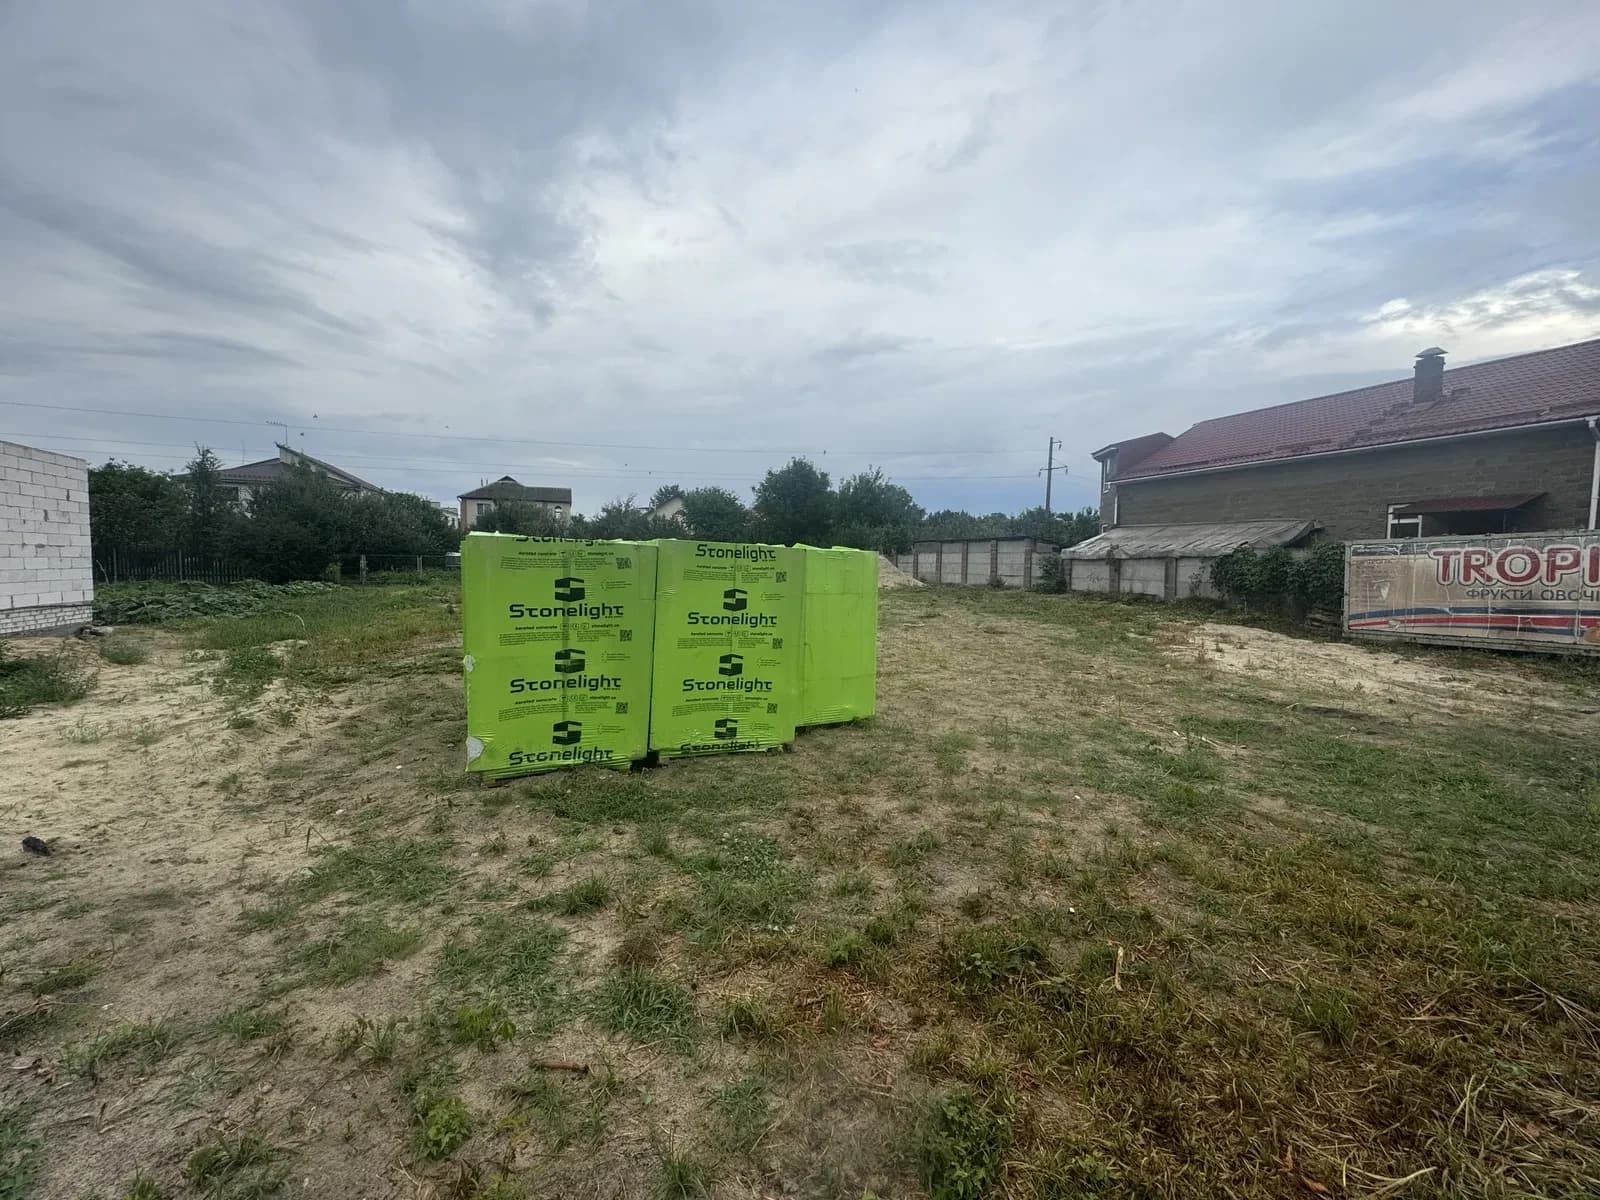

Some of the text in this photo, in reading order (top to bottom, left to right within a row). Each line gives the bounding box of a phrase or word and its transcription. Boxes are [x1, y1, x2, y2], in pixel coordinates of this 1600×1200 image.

[695, 544, 776, 562] Stonelight
[1429, 544, 1600, 587] TROPI
[1466, 589, 1533, 600] ФРУКТИ
[509, 602, 624, 620] Stonelight
[688, 612, 777, 628] Stonelight
[510, 674, 621, 694] Stonelight
[682, 677, 772, 693] Stonelight
[509, 746, 613, 766] Stonelight
